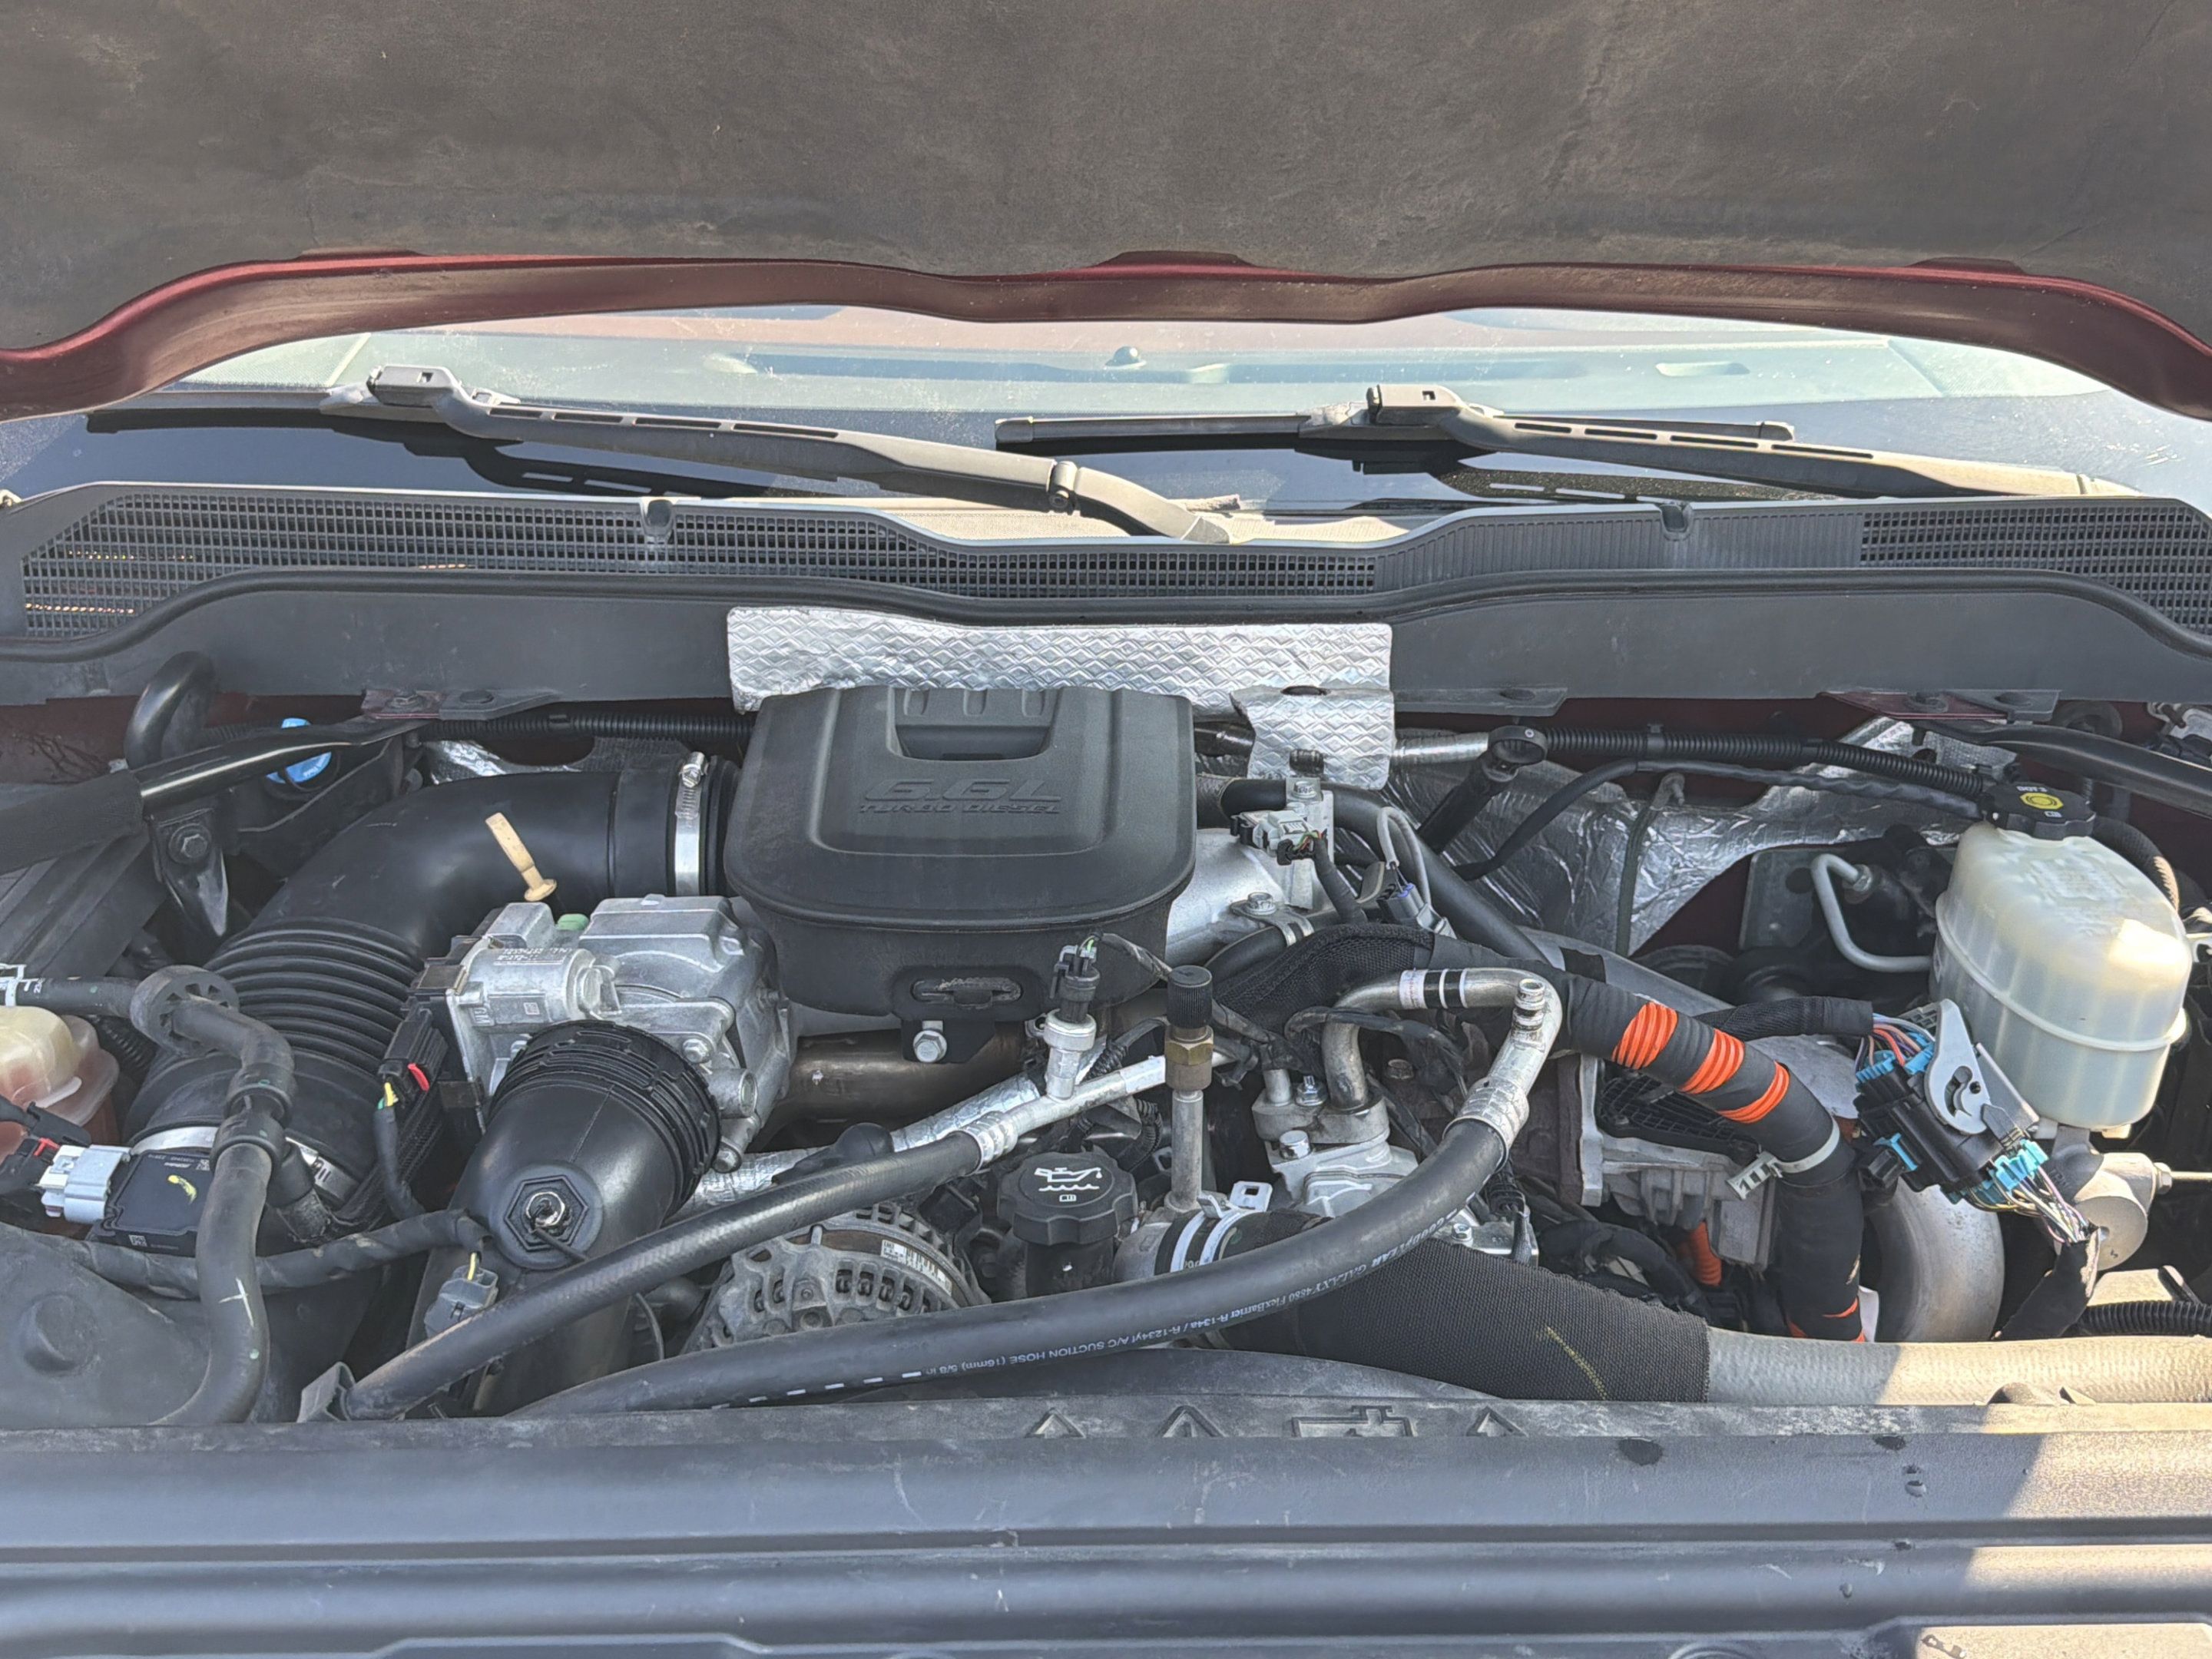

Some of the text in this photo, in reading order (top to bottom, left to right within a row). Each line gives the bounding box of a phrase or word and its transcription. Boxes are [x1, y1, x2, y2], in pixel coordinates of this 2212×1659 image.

[864, 778, 1062, 802] 6.6L
[1313, 1264, 1367, 1294] GALAXY
[1230, 1295, 1286, 1318] FlexBarrier
[1190, 1313, 1229, 1329] R-134a
[1107, 1336, 1129, 1349] A/C
[1132, 1326, 1181, 1343] R-1234yf
[1048, 1341, 1105, 1358] SUCTION
[961, 1356, 1006, 1371] (16mm)
[1008, 1352, 1045, 1364] HOSE
[939, 1364, 958, 1374] 5/8
